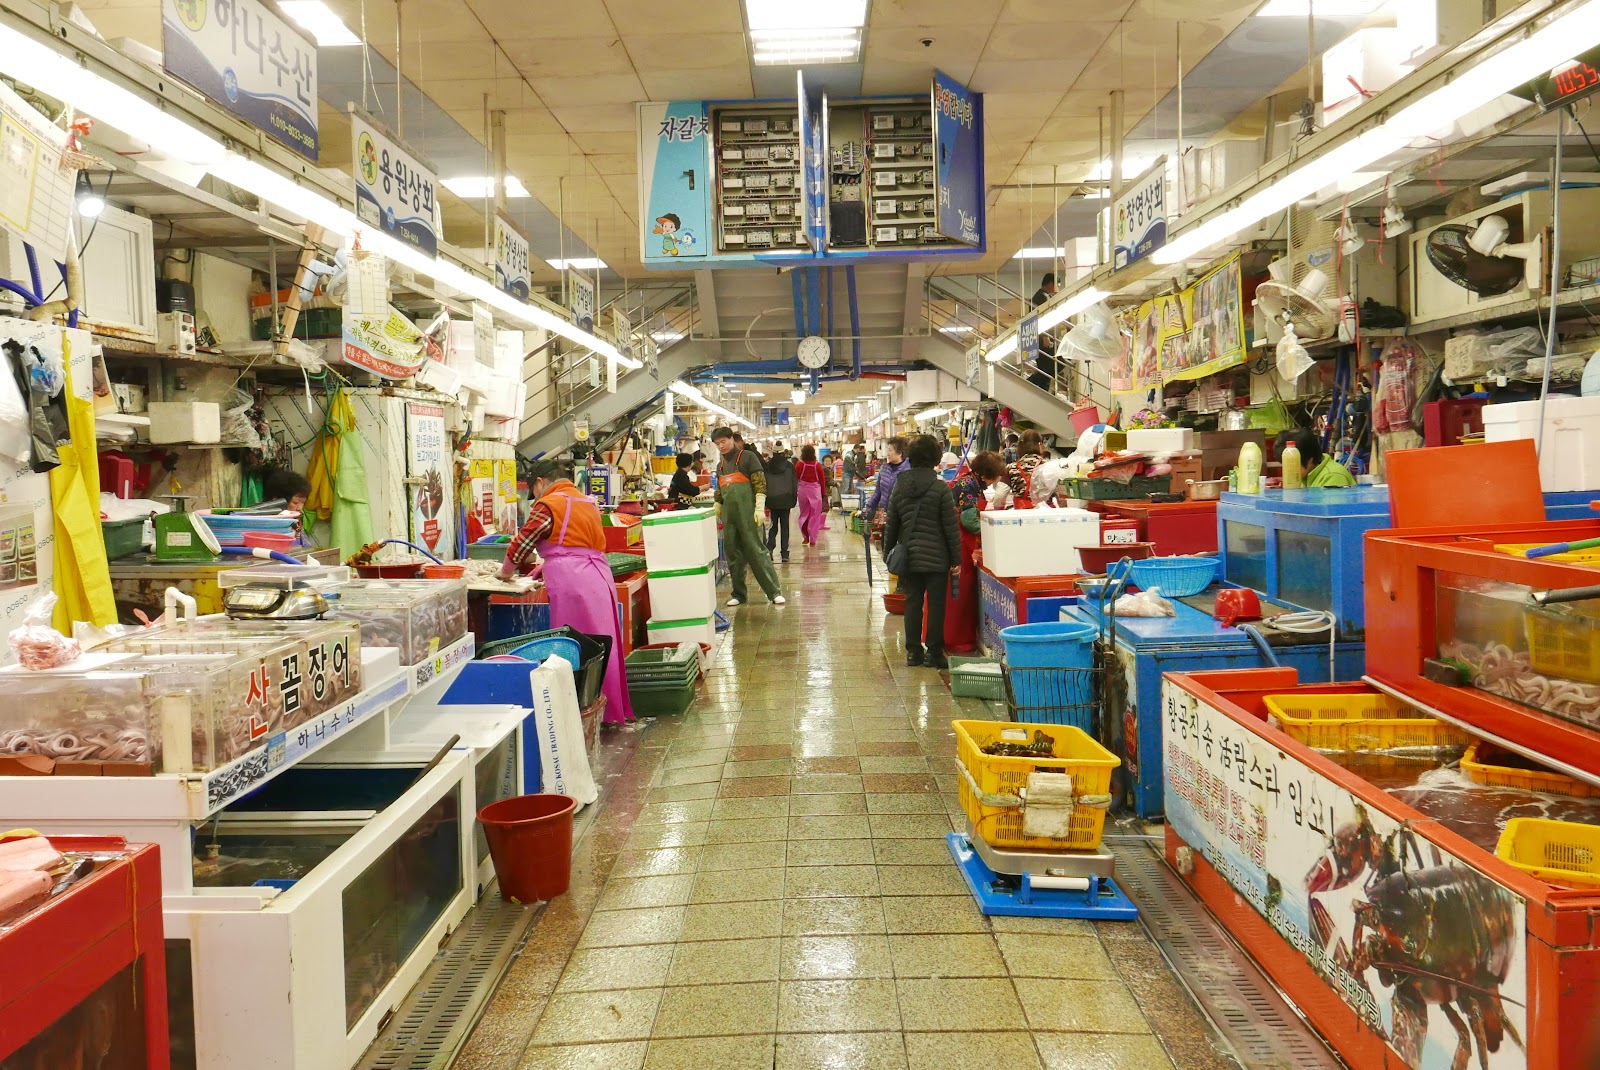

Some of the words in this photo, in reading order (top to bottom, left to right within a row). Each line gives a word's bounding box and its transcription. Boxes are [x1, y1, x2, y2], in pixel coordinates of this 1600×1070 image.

[379, 149, 434, 222] 용원상회
[1127, 176, 1163, 232] 창영상회
[958, 208, 976, 231] Yeah!
[505, 232, 528, 277] 창녕상회
[6, 595, 28, 616] posco
[444, 644, 468, 669] 꼼장어
[246, 664, 270, 741] 산
[280, 636, 350, 714] 꼼장어
[542, 687, 551, 703] LTD.
[298, 703, 355, 749] 하나수산
[548, 720, 560, 754] TRADING
[555, 755, 563, 779] KOSAC
[1168, 696, 1214, 758] 항공직송
[1220, 735, 1281, 808] 活랍스타
